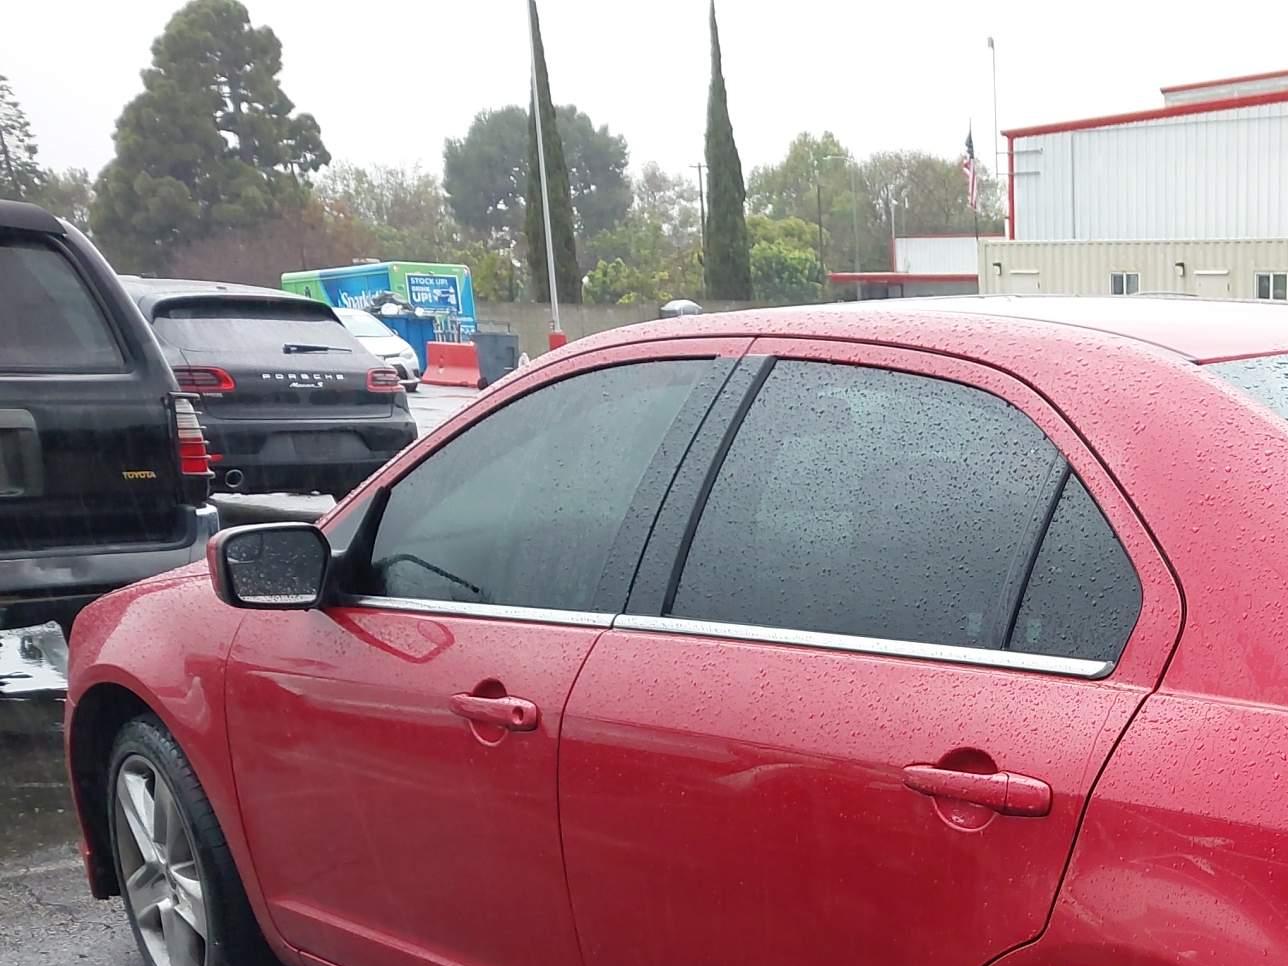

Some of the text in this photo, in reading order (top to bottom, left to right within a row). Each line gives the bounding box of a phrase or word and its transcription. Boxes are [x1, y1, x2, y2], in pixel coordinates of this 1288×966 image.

[410, 277, 434, 285] STOCK
[412, 292, 433, 303] UP!
[122, 471, 157, 479] TOYOTA
